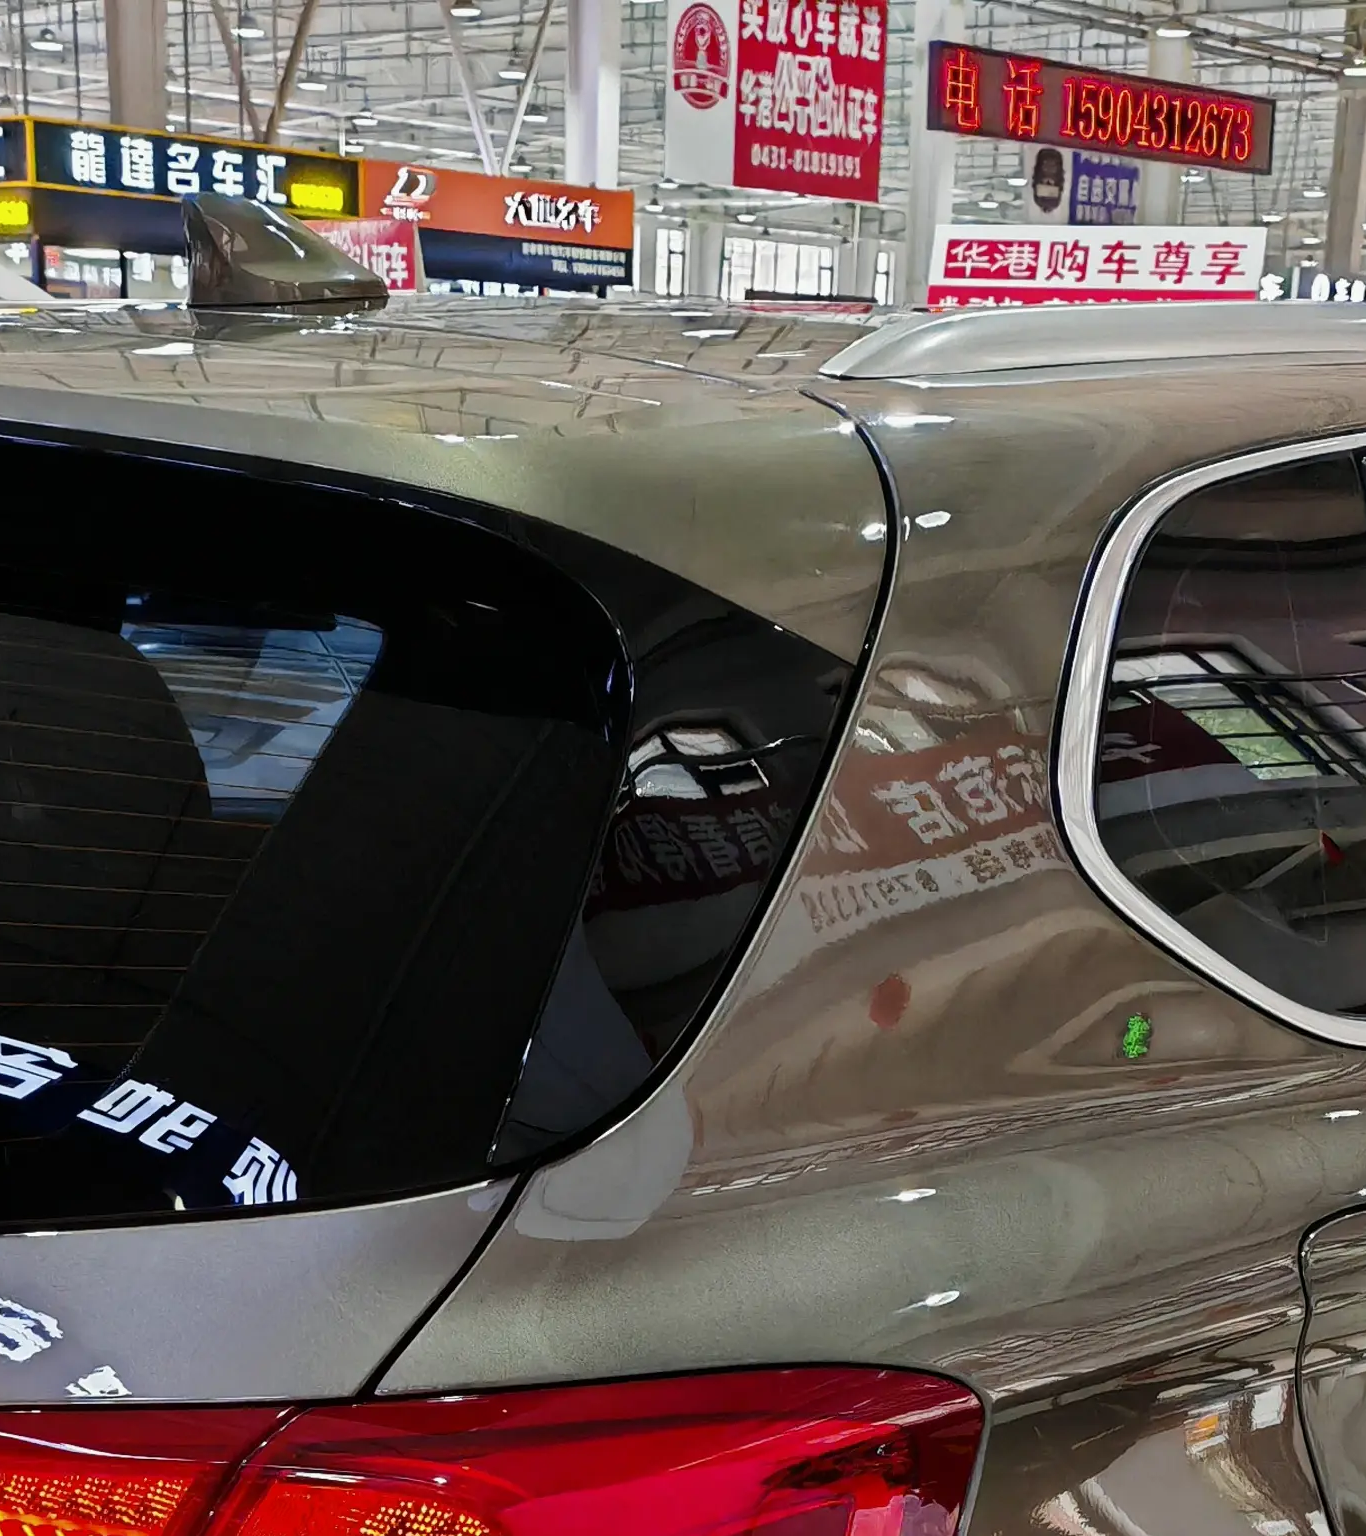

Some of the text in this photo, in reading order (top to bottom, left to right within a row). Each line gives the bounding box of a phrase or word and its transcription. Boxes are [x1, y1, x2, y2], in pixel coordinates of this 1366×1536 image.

[945, 48, 1253, 162] 电话 15904312673
[69, 130, 289, 205] 龍達名车汇
[946, 240, 1249, 285] 华港购车尊享
